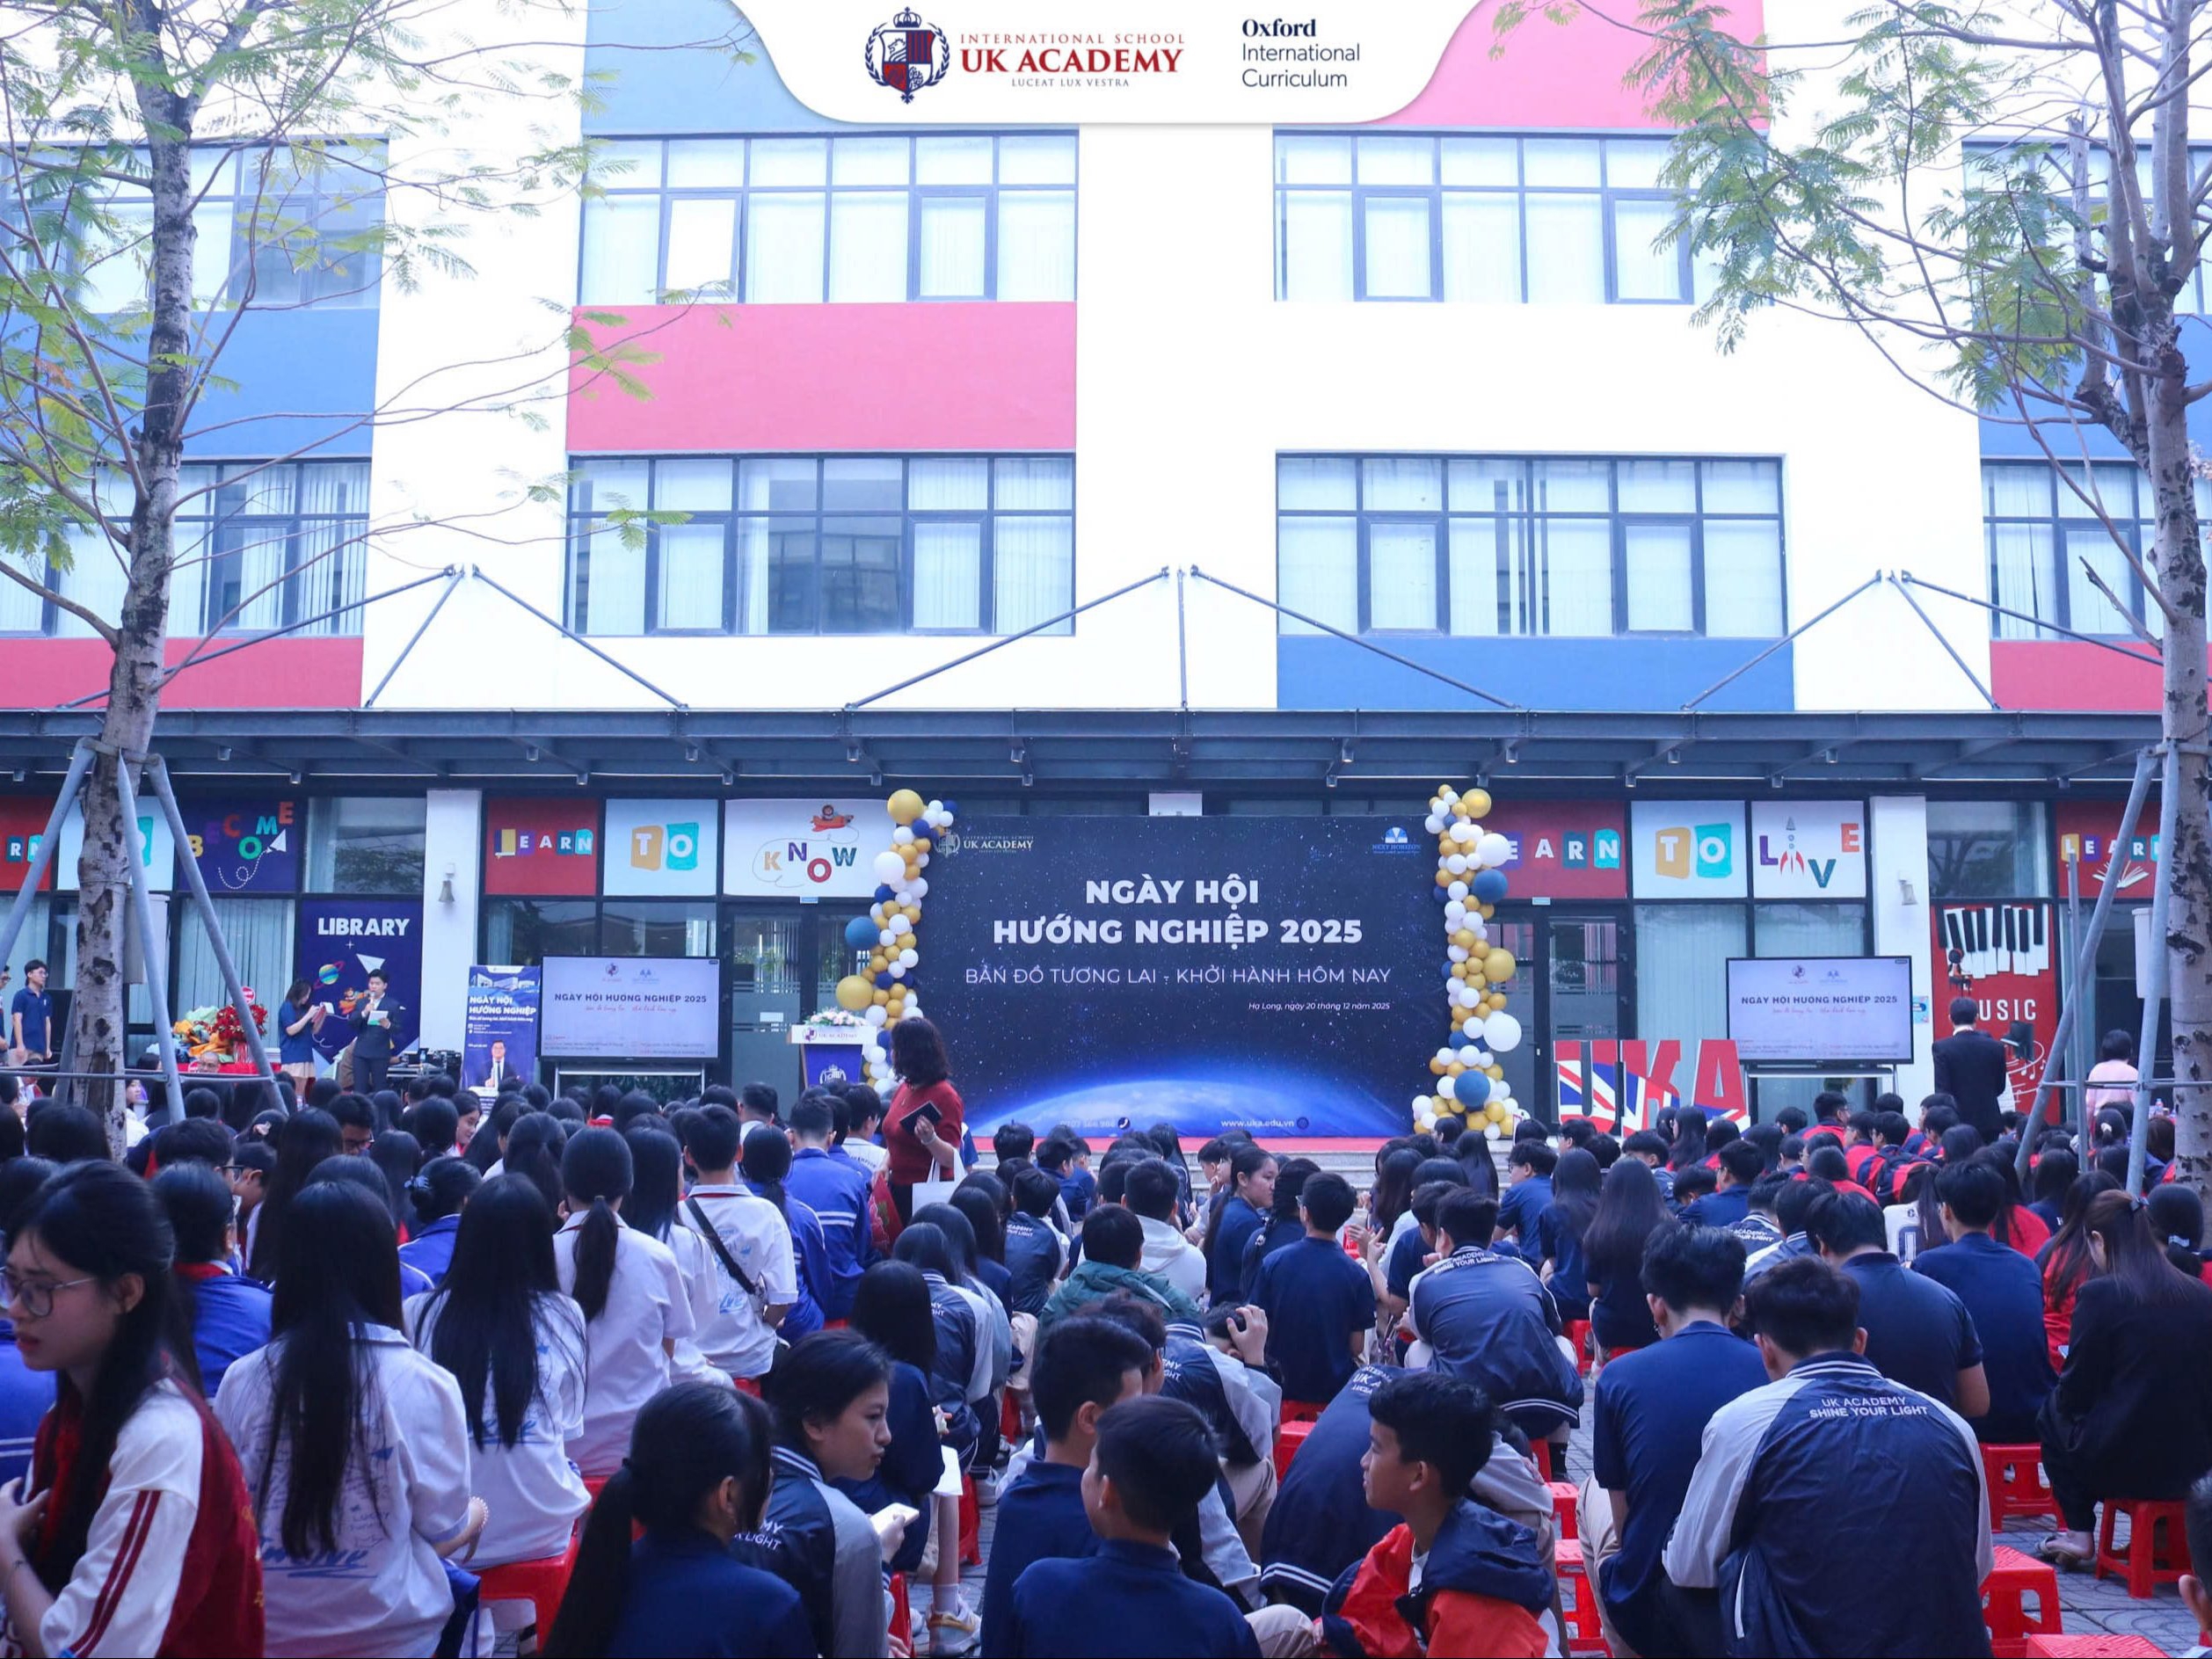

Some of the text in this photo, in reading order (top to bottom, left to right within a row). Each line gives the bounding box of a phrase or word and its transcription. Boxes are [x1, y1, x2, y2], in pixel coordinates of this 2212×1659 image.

[635, 833, 694, 858] TO
[963, 840, 1035, 849] UK ACADEMY
[1507, 838, 1619, 860] EARN
[1660, 835, 1727, 863] TO
[763, 840, 857, 884] KNOW
[1086, 873, 1258, 910] NGÀY HỘI
[317, 918, 410, 936] LIBRARY
[993, 913, 1363, 950] HƯỚNG NGHIỆP 2025
[965, 964, 1007, 984] BẢN
[1013, 964, 1044, 984] ĐỒ
[1050, 966, 1120, 984] TƯƠNG
[1128, 969, 1156, 984] LAI
[1176, 964, 1225, 984] KHỞI
[1233, 965, 1290, 984] HÀNH
[1298, 965, 1344, 984] HÔM
[1352, 968, 1391, 984] NAY
[684, 994, 707, 1003] 2025
[1262, 1002, 1283, 1011] Long,
[1284, 1002, 1305, 1011] ngày
[1317, 1001, 1342, 1011] tháng
[1874, 995, 1898, 1004] 2025
[1978, 999, 2036, 1022] USIC
[1553, 1038, 1752, 1140] UKA
[1220, 1119, 1295, 1128] www.uka.edu.vn
[1821, 1396, 1906, 1407] UK ACADEMY
[1808, 1406, 1928, 1419] SHINE YOUR LIGHT
[745, 1531, 782, 1550] LIGHT
